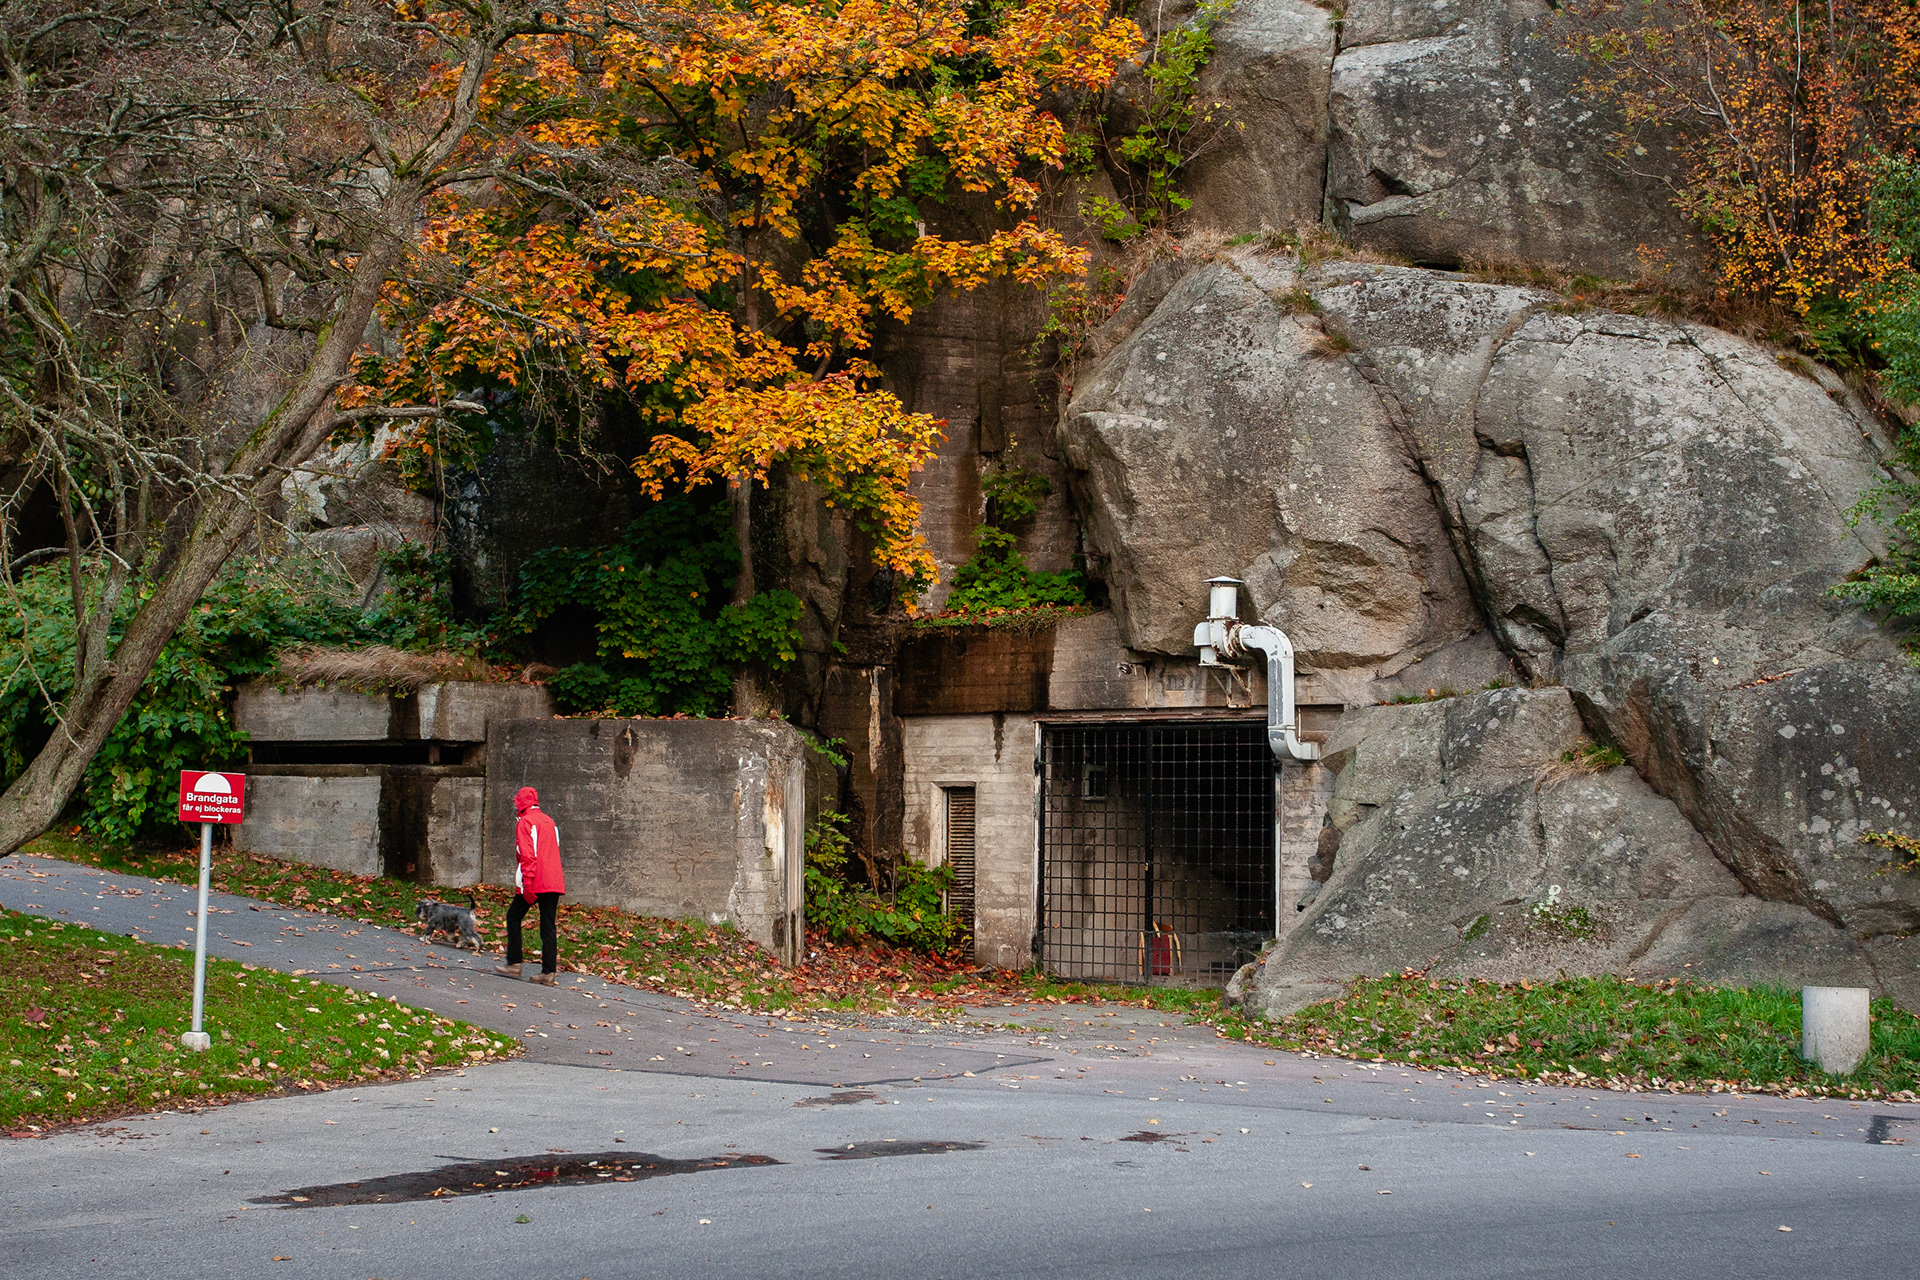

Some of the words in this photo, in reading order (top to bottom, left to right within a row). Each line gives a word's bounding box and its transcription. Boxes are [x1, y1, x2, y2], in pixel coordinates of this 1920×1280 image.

[186, 792, 238, 804] Brandgata
[182, 803, 194, 811] får
[195, 804, 202, 813] ej
[204, 805, 241, 813] blockeras
